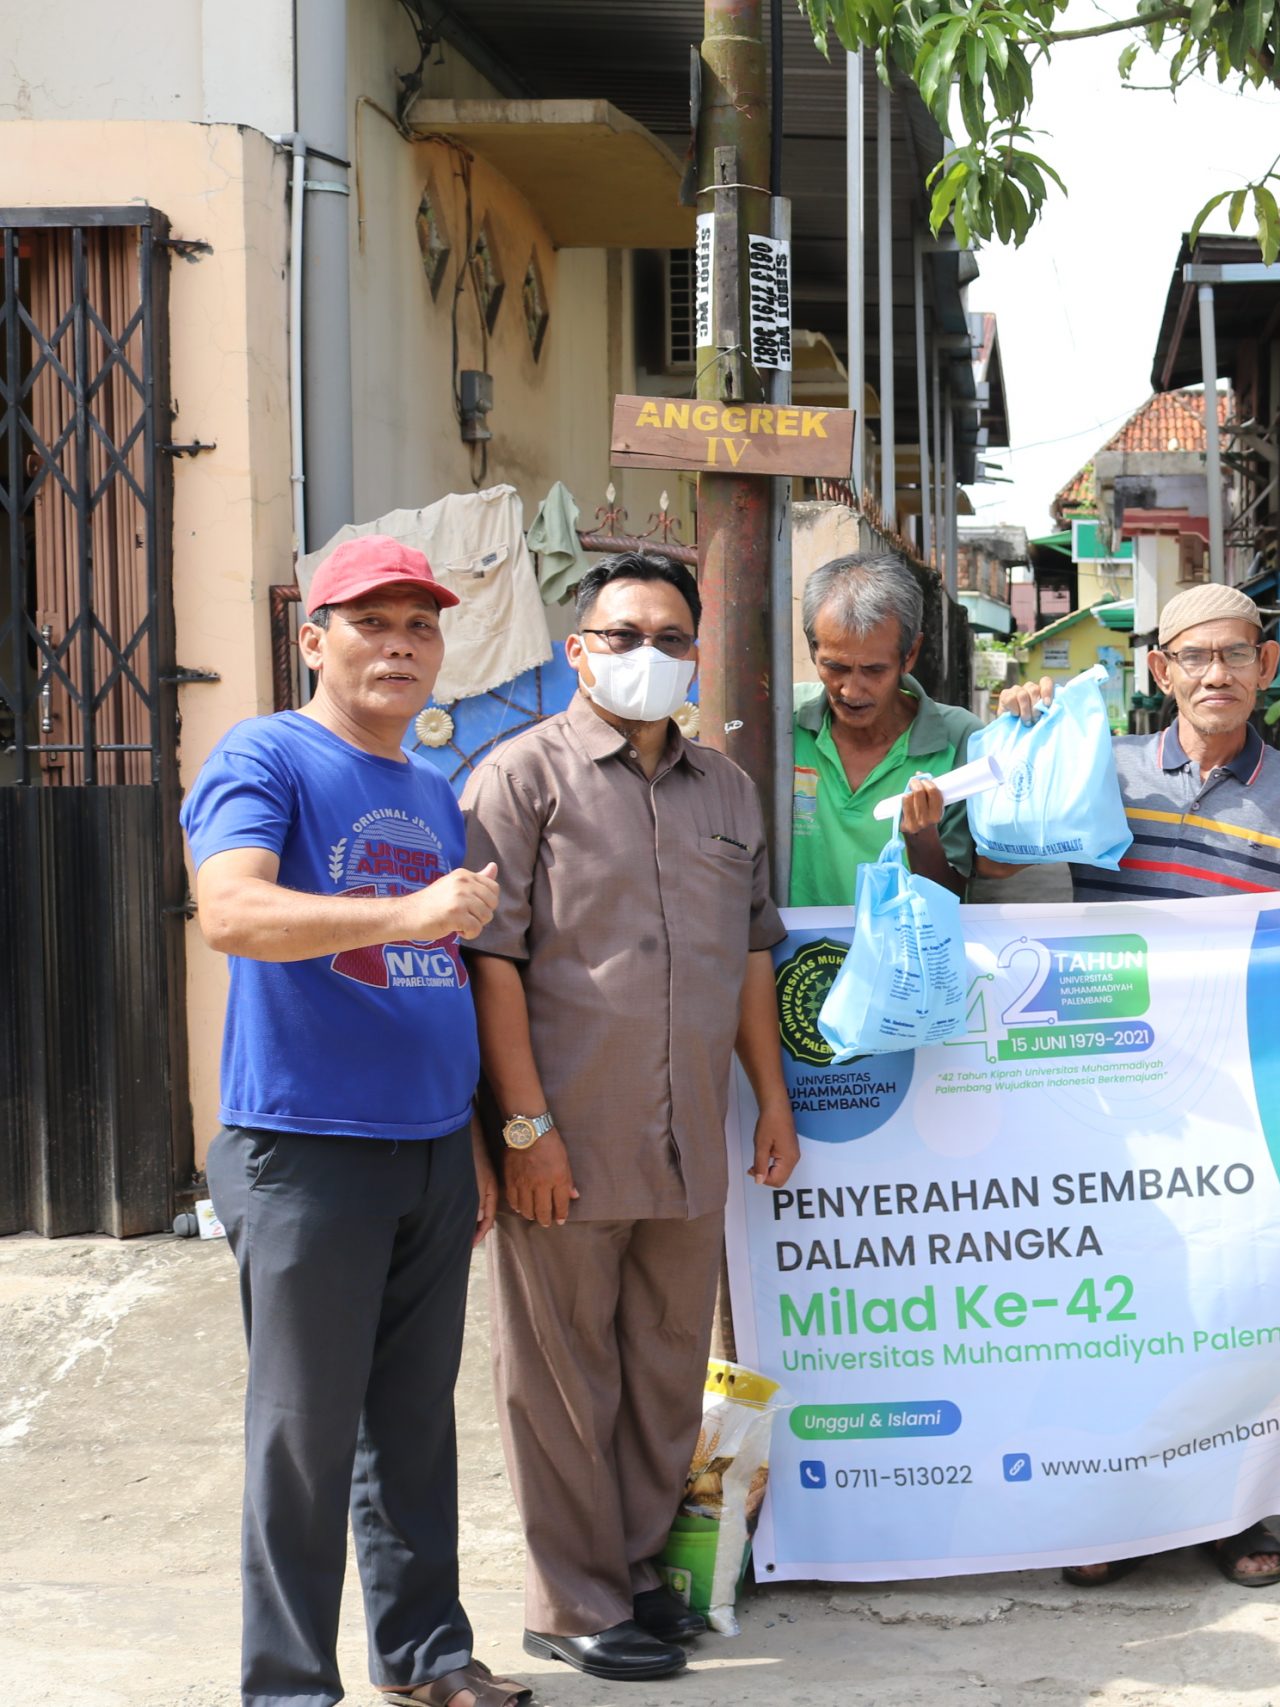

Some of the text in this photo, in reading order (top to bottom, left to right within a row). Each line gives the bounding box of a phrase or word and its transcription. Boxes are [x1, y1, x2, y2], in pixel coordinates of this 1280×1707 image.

[700, 227, 711, 338] SEDOT WC
[750, 242, 779, 366] 0813 7791 3887
[775, 253, 791, 362] SEDOT WC
[635, 401, 829, 439] ANGGREK
[704, 436, 752, 468] IV
[352, 808, 409, 833] ORIGINAL
[364, 840, 439, 869] UNDER
[386, 951, 454, 977] NYC
[1053, 951, 1144, 973] TAHUN
[393, 976, 455, 987] APPAREL COMPANY
[1059, 973, 1114, 985] UNIVERSITAS
[1060, 983, 1134, 995] MUHAMMADIYAH
[782, 958, 816, 1032] UNIVERSITAS
[1061, 995, 1113, 1006] PALEMBANG
[1011, 1030, 1149, 1053] 15 JUNI 1979-2021
[796, 1072, 871, 1087] UNIVERSITAS
[957, 1071, 988, 1081] Tahun
[990, 1068, 1022, 1080] Kiprah
[1024, 1064, 1079, 1077] Universitas
[1081, 1059, 1164, 1073] Muhammadiyah
[786, 1081, 896, 1100] UHAMMADIYAH
[935, 1083, 992, 1094] Palembang
[994, 1080, 1044, 1092] Wujudkan
[1047, 1077, 1096, 1087] Indonesia
[792, 1096, 880, 1113] PALEMBANG
[772, 1162, 1256, 1221] PENYERAHAN SEMBAKO
[776, 1225, 1104, 1272] DALAM RANGKA
[779, 1275, 1138, 1338] Milad Ke-42
[782, 1342, 935, 1372] Universitas
[943, 1332, 1185, 1367] Muhammadiyah
[804, 1410, 941, 1434] Unggul & Islami
[835, 1465, 974, 1489] 0711-513022
